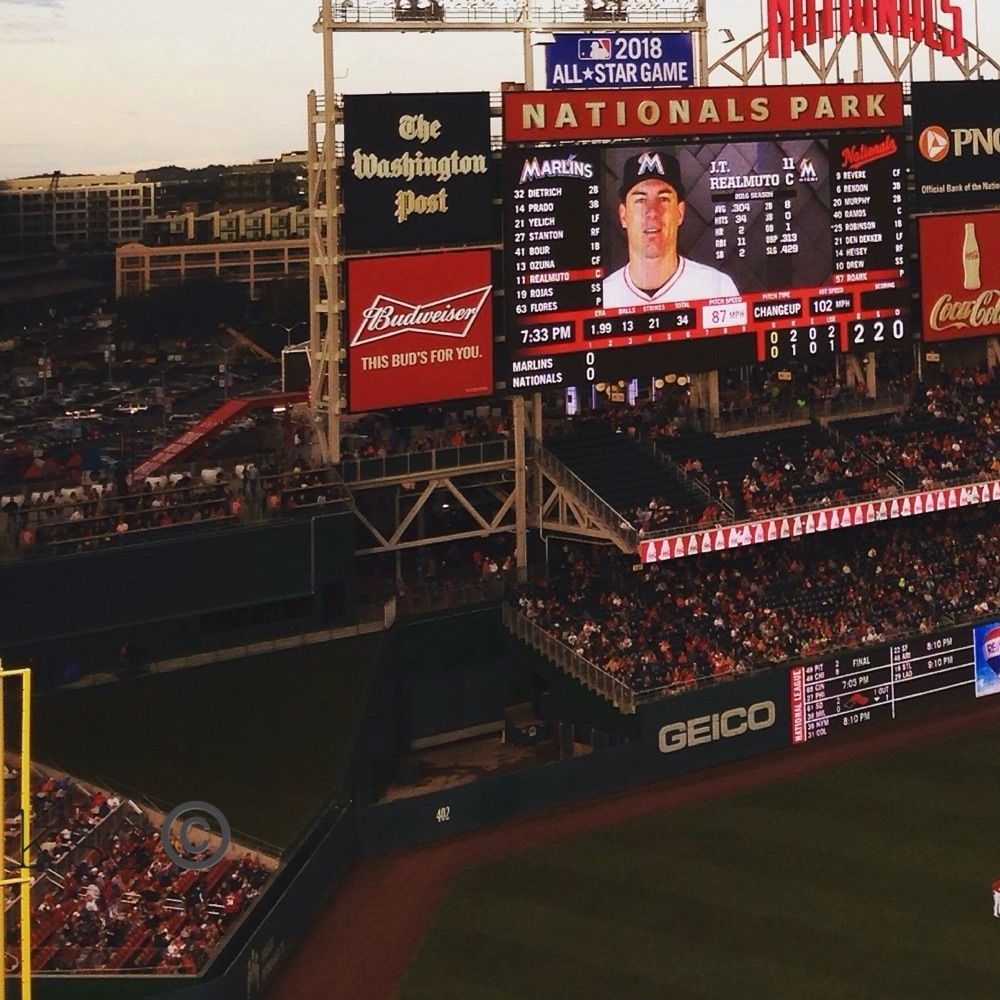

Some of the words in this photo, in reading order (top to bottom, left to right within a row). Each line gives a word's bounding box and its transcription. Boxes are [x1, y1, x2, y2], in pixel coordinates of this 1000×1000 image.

[615, 37, 663, 60] 2018
[553, 64, 582, 84] ALL
[595, 63, 637, 83] STAR
[640, 61, 688, 81] GAME
[521, 96, 771, 130] NATIONALS
[790, 92, 887, 120] PARK
[398, 114, 442, 143] The
[842, 135, 898, 168] Nationals
[352, 148, 488, 182] Washington
[519, 156, 593, 183] MARLINS
[710, 161, 730, 174] J.T.
[783, 157, 795, 170] 11
[710, 175, 779, 190] REALMUTO
[785, 173, 794, 185] C
[844, 171, 866, 180] REVERE
[514, 189, 524, 199] 32
[528, 187, 562, 198] DIETRICH
[921, 184, 946, 194] Official
[947, 184, 962, 193] Bank
[964, 183, 972, 191] of
[972, 183, 981, 191] the
[394, 189, 449, 223] Post
[844, 197, 870, 206] MURPHY
[515, 205, 525, 213] 14
[528, 203, 554, 213] PRADO
[515, 219, 524, 228] 21
[528, 217, 555, 227] YELICH
[845, 222, 876, 231] ROBINSON
[515, 233, 525, 242] 27
[529, 230, 563, 241] STANTON
[835, 237, 843, 245] 21
[859, 234, 882, 243] DEKKER
[515, 248, 525, 257] 41
[530, 246, 550, 256] BOUR
[516, 262, 526, 271] 13
[530, 260, 555, 270] OZUNA
[847, 261, 864, 270] DREW
[516, 276, 526, 285] 11
[530, 272, 570, 284] REALMUTO
[517, 290, 526, 299] 19
[531, 288, 553, 298] ROJAS
[516, 305, 526, 314] 63
[531, 302, 558, 313] FLORES
[754, 304, 801, 318] CHANGEUP
[814, 300, 832, 312] 102
[835, 300, 850, 309] MPH
[363, 304, 479, 331] Budweiser
[676, 315, 688, 326] 34
[712, 310, 727, 323] 87
[591, 323, 612, 335] 1.99
[622, 321, 634, 332] 13
[649, 318, 660, 329] 21
[521, 328, 549, 343] 7:33
[552, 325, 571, 341] PM
[854, 324, 865, 344] 2
[874, 322, 884, 342] 2
[893, 320, 904, 339] 0
[513, 358, 553, 372] MARLINS
[586, 352, 594, 366] 0
[771, 332, 778, 344] 0
[790, 330, 797, 342] 2
[809, 327, 817, 340] 0
[828, 326, 835, 338] 2
[361, 356, 389, 370] THIS
[392, 352, 428, 367] BUD'S
[431, 349, 453, 363] FOR
[456, 346, 482, 359] YOU.
[513, 372, 563, 388] NATIONALS
[586, 368, 594, 381] 0
[771, 346, 778, 358] 0
[792, 344, 796, 356] 1
[810, 342, 817, 354] 0
[830, 340, 834, 352] 1
[943, 638, 952, 646] PM
[853, 657, 870, 667] FINAL
[943, 656, 953, 665] PM
[859, 676, 869, 684] PM
[878, 686, 889, 695] OUT
[860, 712, 870, 721] PM
[658, 699, 776, 755] GEICO
[436, 806, 450, 822] 402
